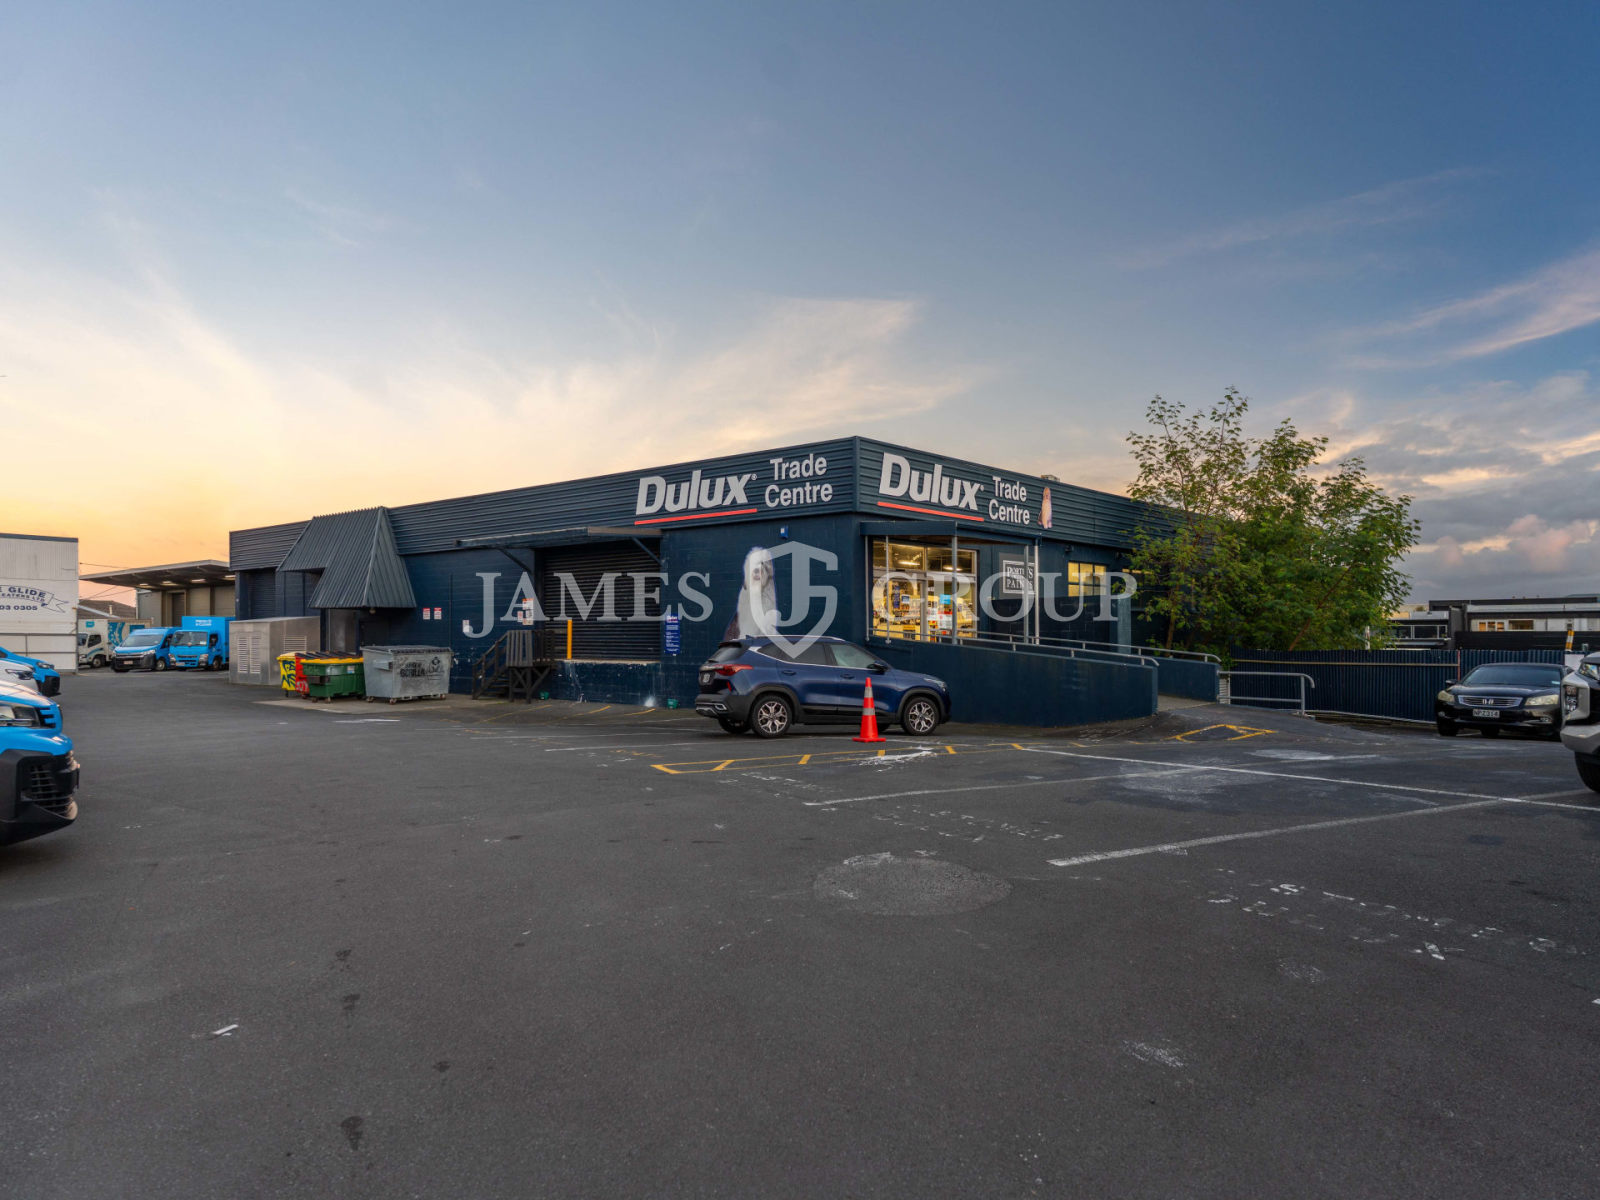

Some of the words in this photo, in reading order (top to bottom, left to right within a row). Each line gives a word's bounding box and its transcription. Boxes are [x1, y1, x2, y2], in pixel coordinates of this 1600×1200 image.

[770, 454, 827, 480] Trade
[635, 470, 752, 515] Dulux
[879, 452, 981, 511] Dulux
[992, 475, 1027, 502] Trade
[764, 482, 833, 508] Centre
[988, 499, 1031, 525] Centre
[1006, 566, 1034, 579] PORT'S
[1006, 578, 1034, 590] PAINS
[8, 586, 47, 598] GLIDE
